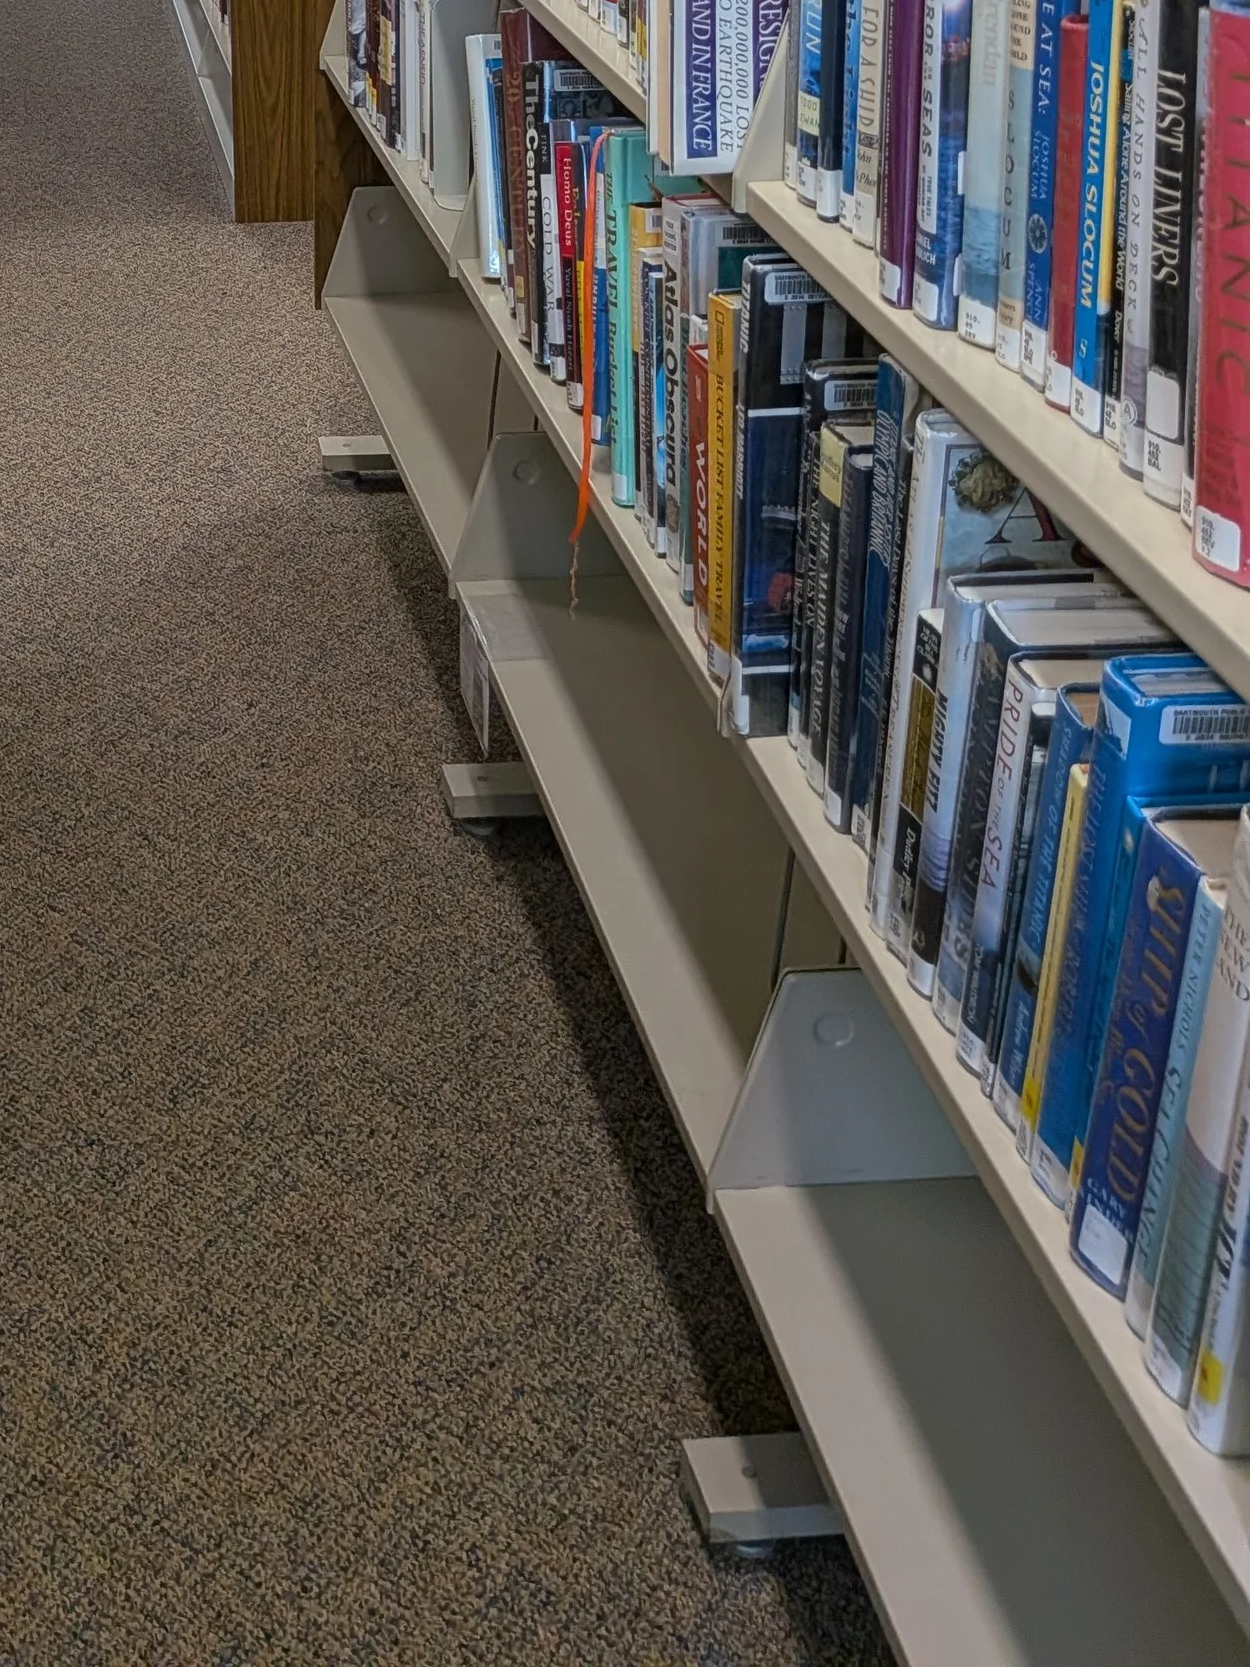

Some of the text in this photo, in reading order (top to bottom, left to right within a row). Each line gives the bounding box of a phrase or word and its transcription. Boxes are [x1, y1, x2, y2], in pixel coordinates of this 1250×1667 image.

[692, 44, 712, 66] IN
[861, 6, 880, 48] FOR
[1040, 23, 1054, 57] AT
[692, 68, 713, 151] FRANCE
[716, 17, 734, 153] EARTHQUAKE
[858, 77, 876, 127] SHIP
[920, 86, 933, 158] SEAS
[563, 157, 573, 247] Homo Deus
[1000, 91, 1016, 272] SLOCUM
[1039, 134, 1050, 200] JOSHUA
[1080, 60, 1104, 309] JOSHUA SLOCUM
[1126, 91, 1146, 311] HANDS ON DECK
[1152, 68, 1186, 286] LOST LINERS
[1115, 126, 1130, 291] Alone Around World
[606, 211, 619, 310] TRAVEL
[663, 259, 679, 341] Atlas
[739, 282, 751, 354] TITANIC
[664, 349, 679, 487] Obscura
[714, 373, 726, 453] BUCKET
[714, 454, 725, 486] LIST
[1147, 458, 1162, 472] BAL
[695, 441, 708, 587] WORLD
[713, 488, 725, 551] FAMILY
[712, 552, 724, 623] TRAVEL
[931, 688, 949, 770] MIGHTY
[981, 680, 1023, 890] PRIDE SEA
[1029, 876, 1050, 944] TITANIC
[1107, 868, 1185, 1204] SHIP GOLD
